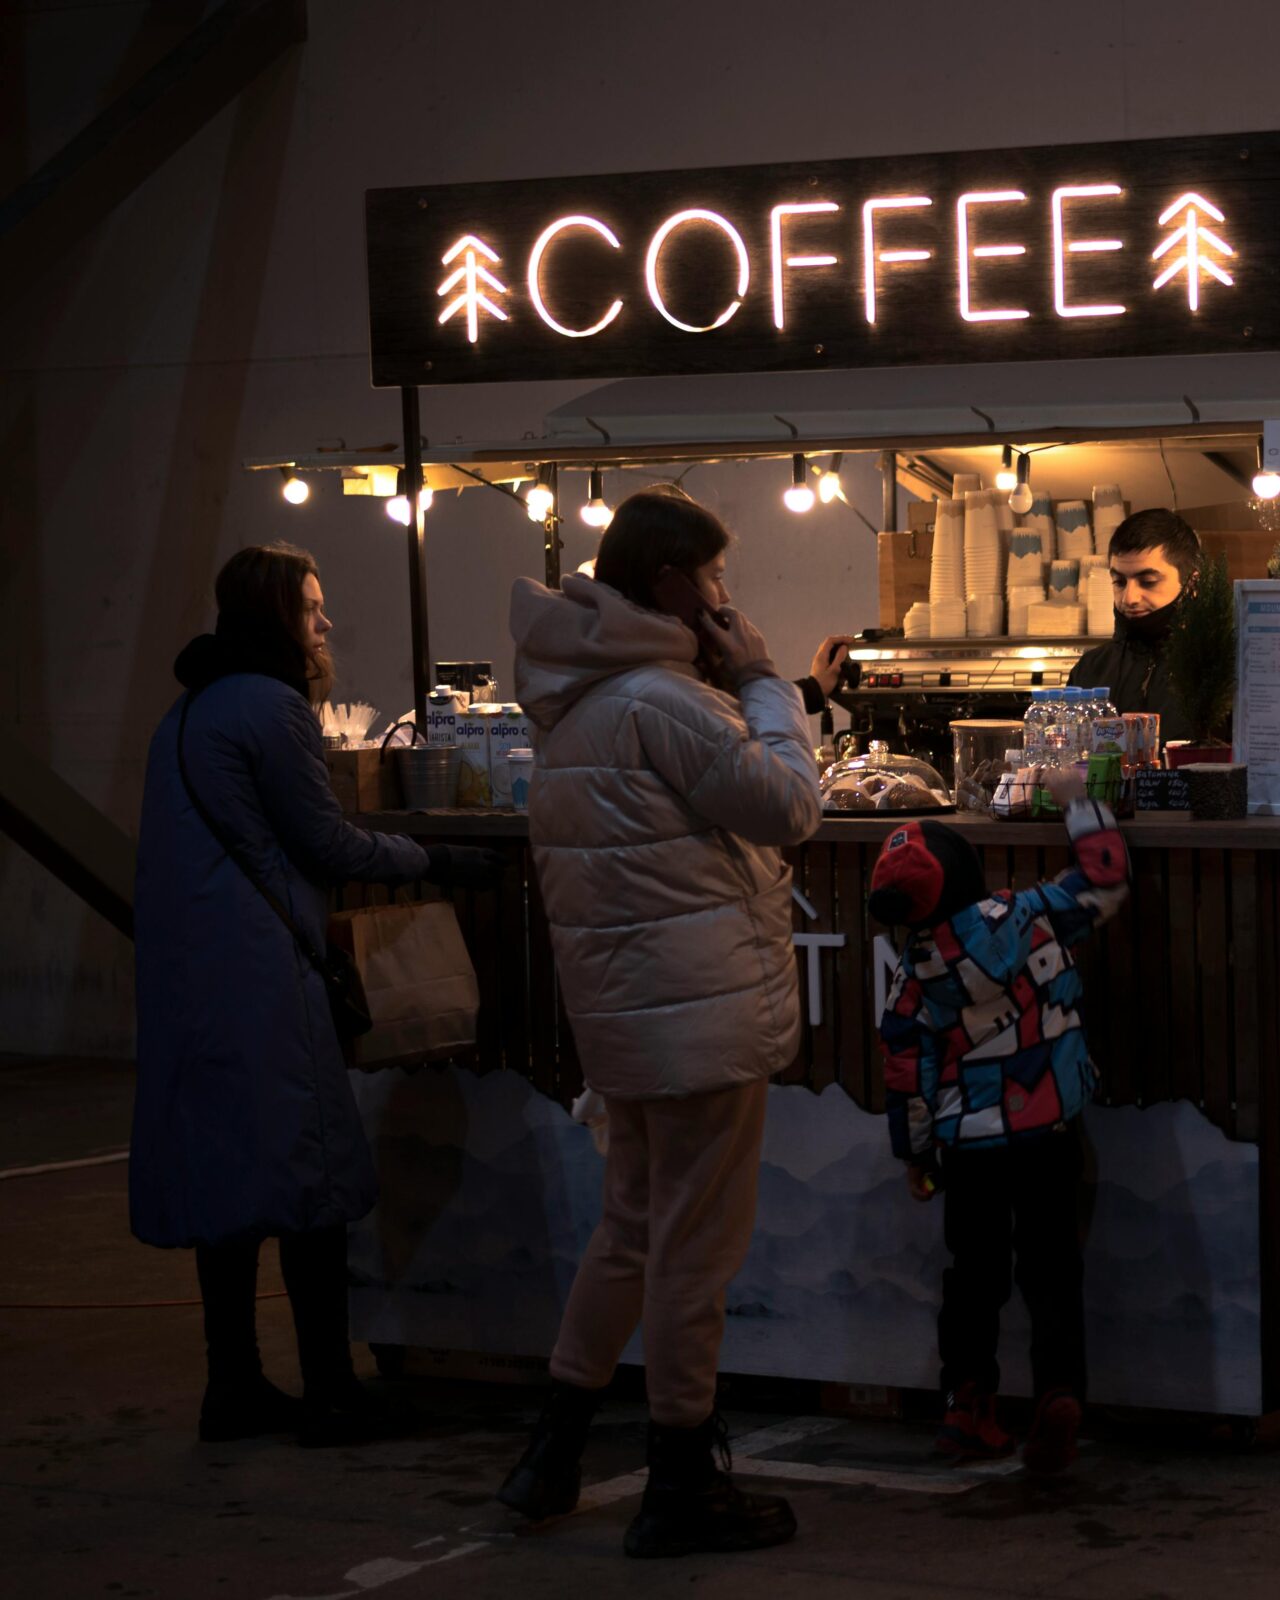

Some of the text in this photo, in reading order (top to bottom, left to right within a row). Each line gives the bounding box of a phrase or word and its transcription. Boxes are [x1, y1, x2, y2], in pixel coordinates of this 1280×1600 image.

[527, 184, 1127, 338] COFFEE
[456, 723, 484, 737] alpro
[490, 723, 518, 738] alpro
